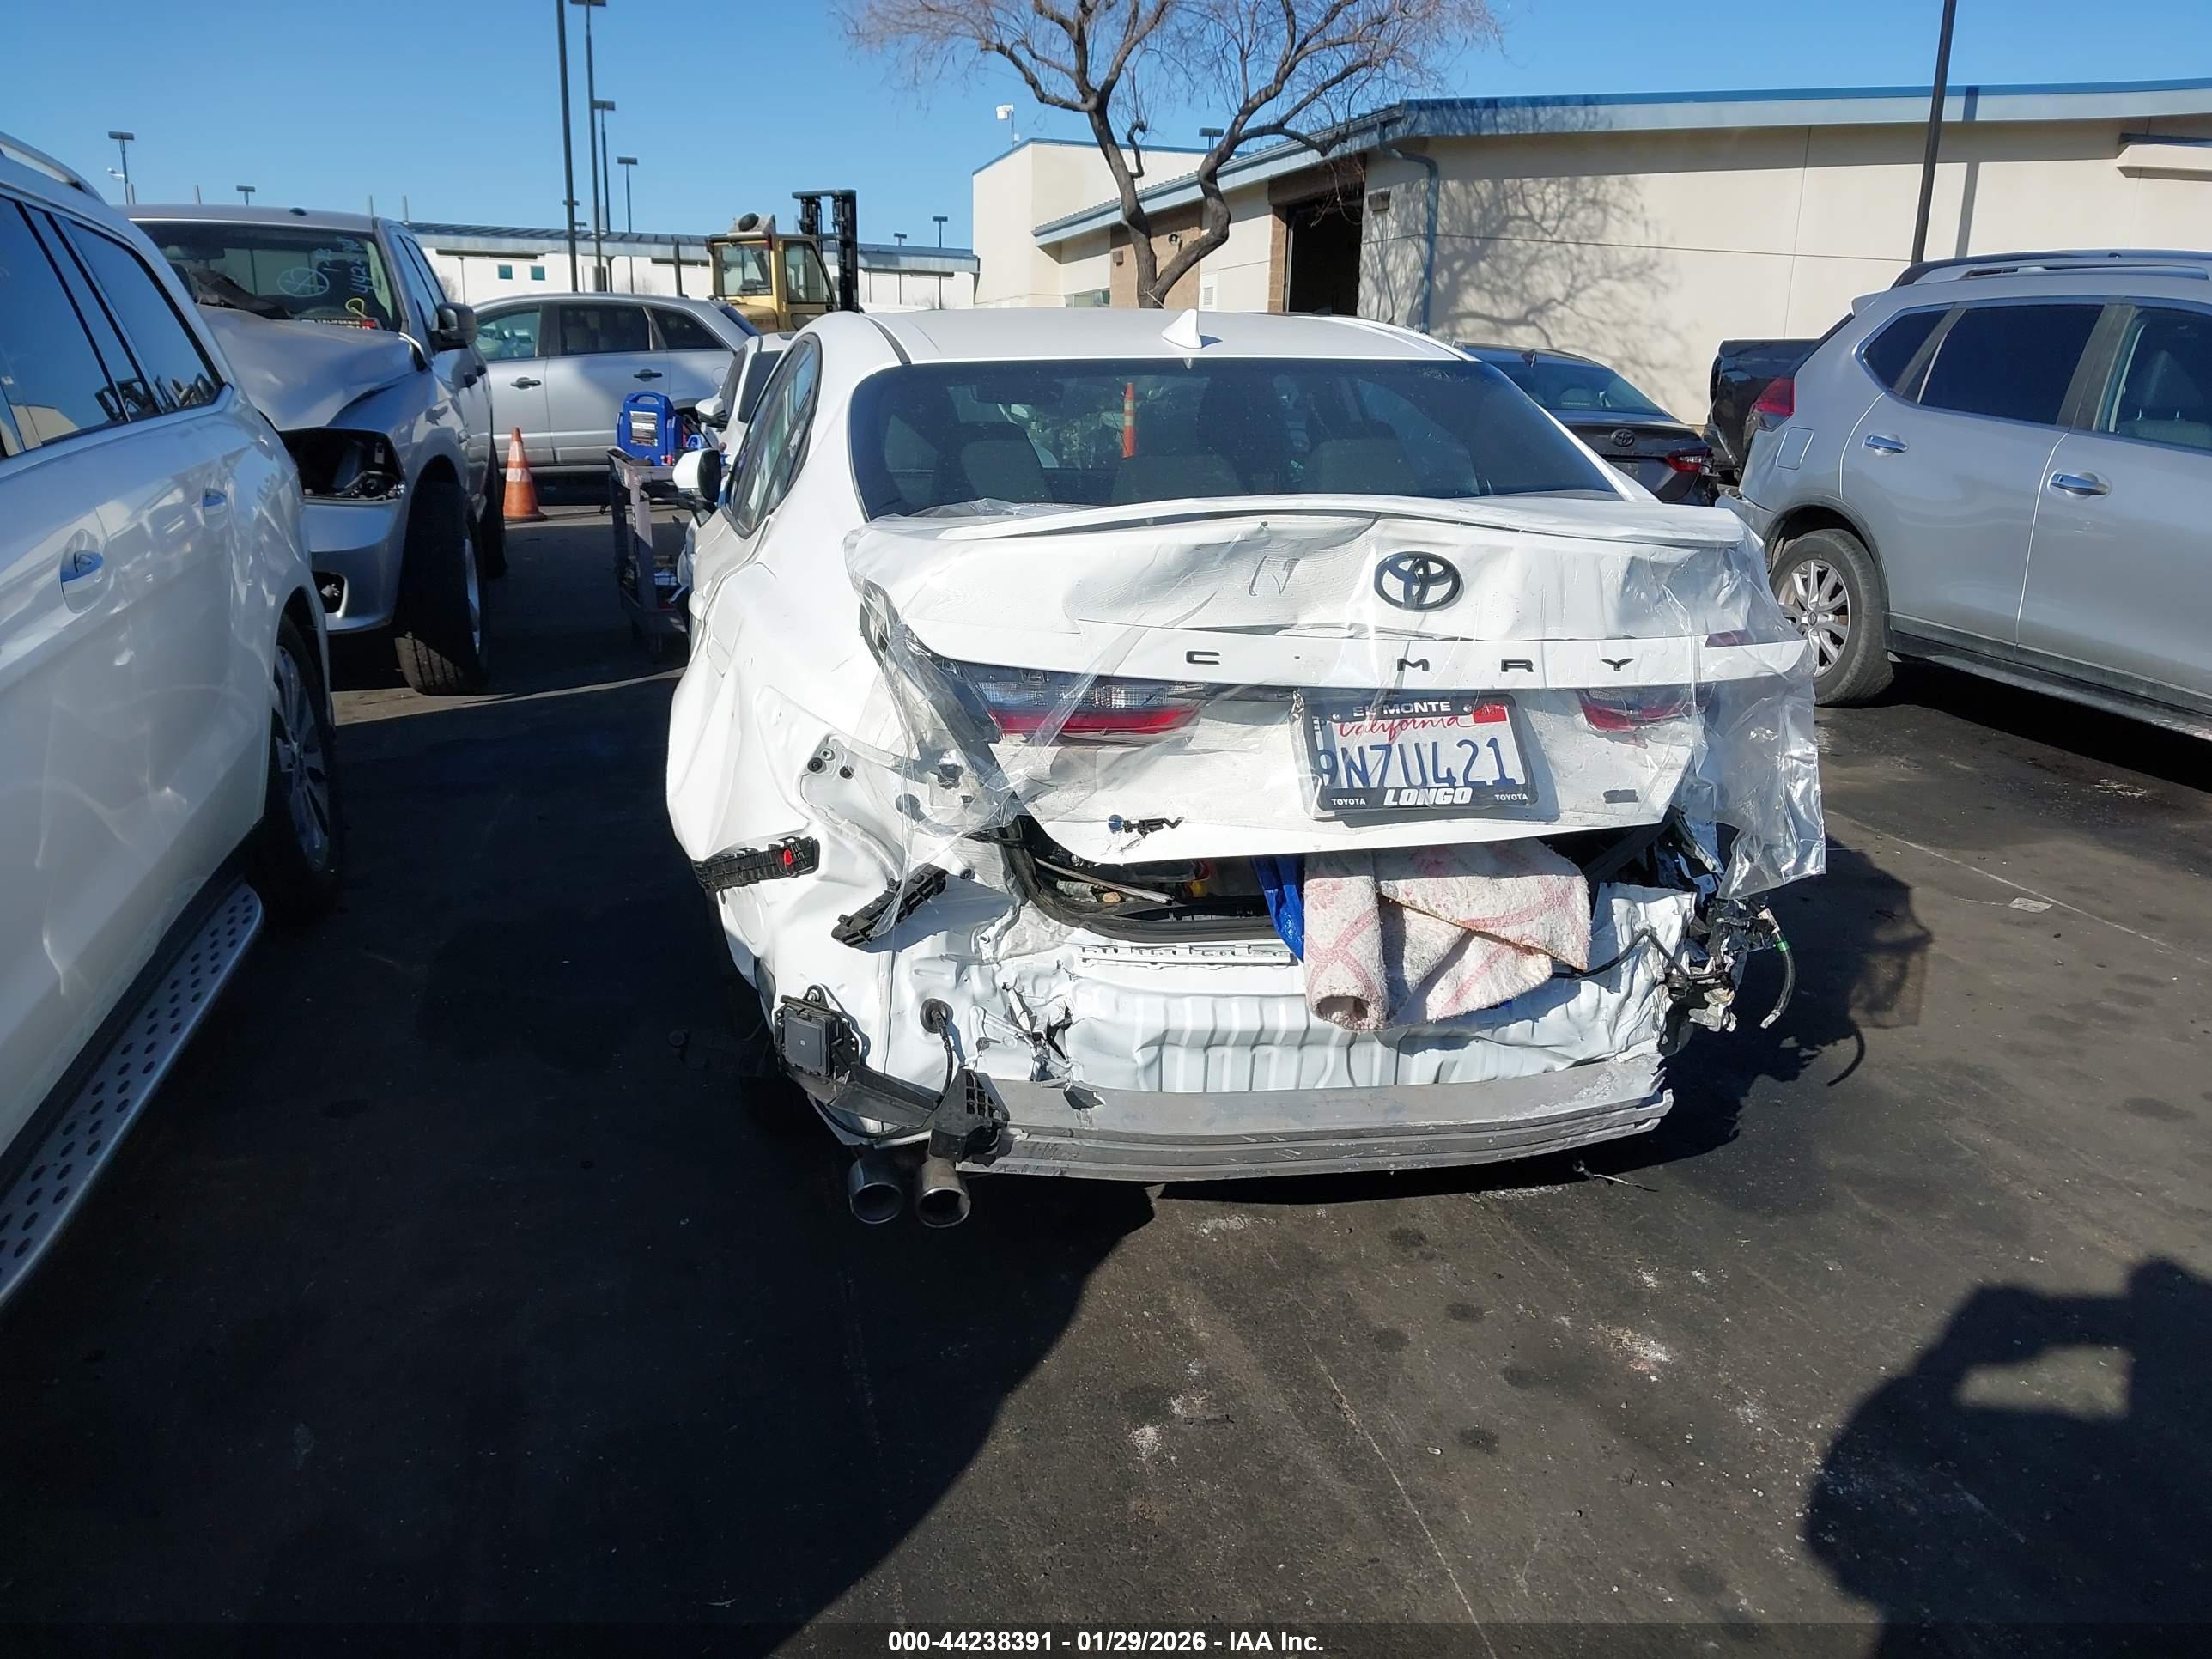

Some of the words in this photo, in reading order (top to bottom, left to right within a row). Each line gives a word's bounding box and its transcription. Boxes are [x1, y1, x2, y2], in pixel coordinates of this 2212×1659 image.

[1382, 701, 1451, 715] MONTE
[1339, 714, 1475, 742] California
[1331, 797, 1366, 806] TOYOTA
[1383, 787, 1473, 806] LONGO
[1494, 793, 1528, 802] TOYOTA
